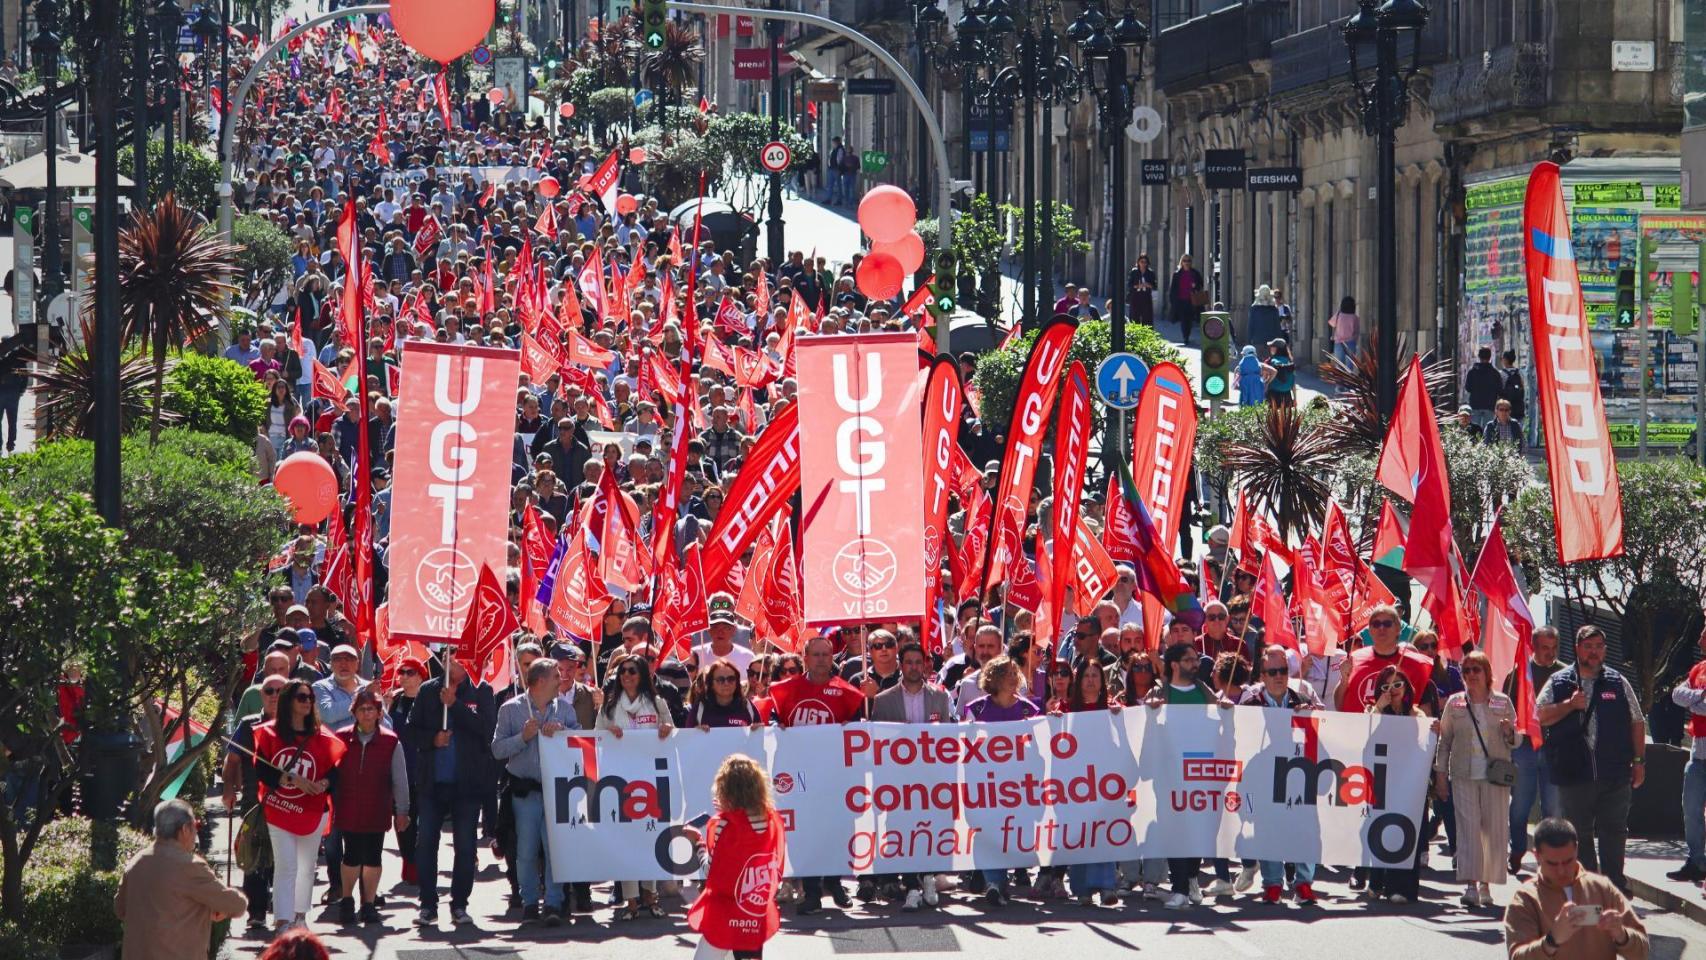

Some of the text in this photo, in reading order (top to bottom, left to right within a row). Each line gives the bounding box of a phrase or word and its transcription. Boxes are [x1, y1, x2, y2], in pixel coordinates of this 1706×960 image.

[767, 150, 785, 162] 40
[1143, 164, 1165, 172] casa
[1250, 174, 1298, 184] BERSHKA
[1012, 340, 1060, 486] UGT
[428, 354, 484, 545] UGT
[833, 352, 886, 536] UGT
[933, 377, 956, 515] UGT
[842, 599, 888, 615] VIGO
[793, 706, 830, 726] UGT
[843, 729, 1079, 768] Protexer o
[1187, 763, 1239, 778] CCOO
[845, 764, 1137, 821] conquistado,
[1171, 789, 1222, 812] UGT
[847, 820, 982, 871] gañar
[1001, 815, 1132, 854] futuro
